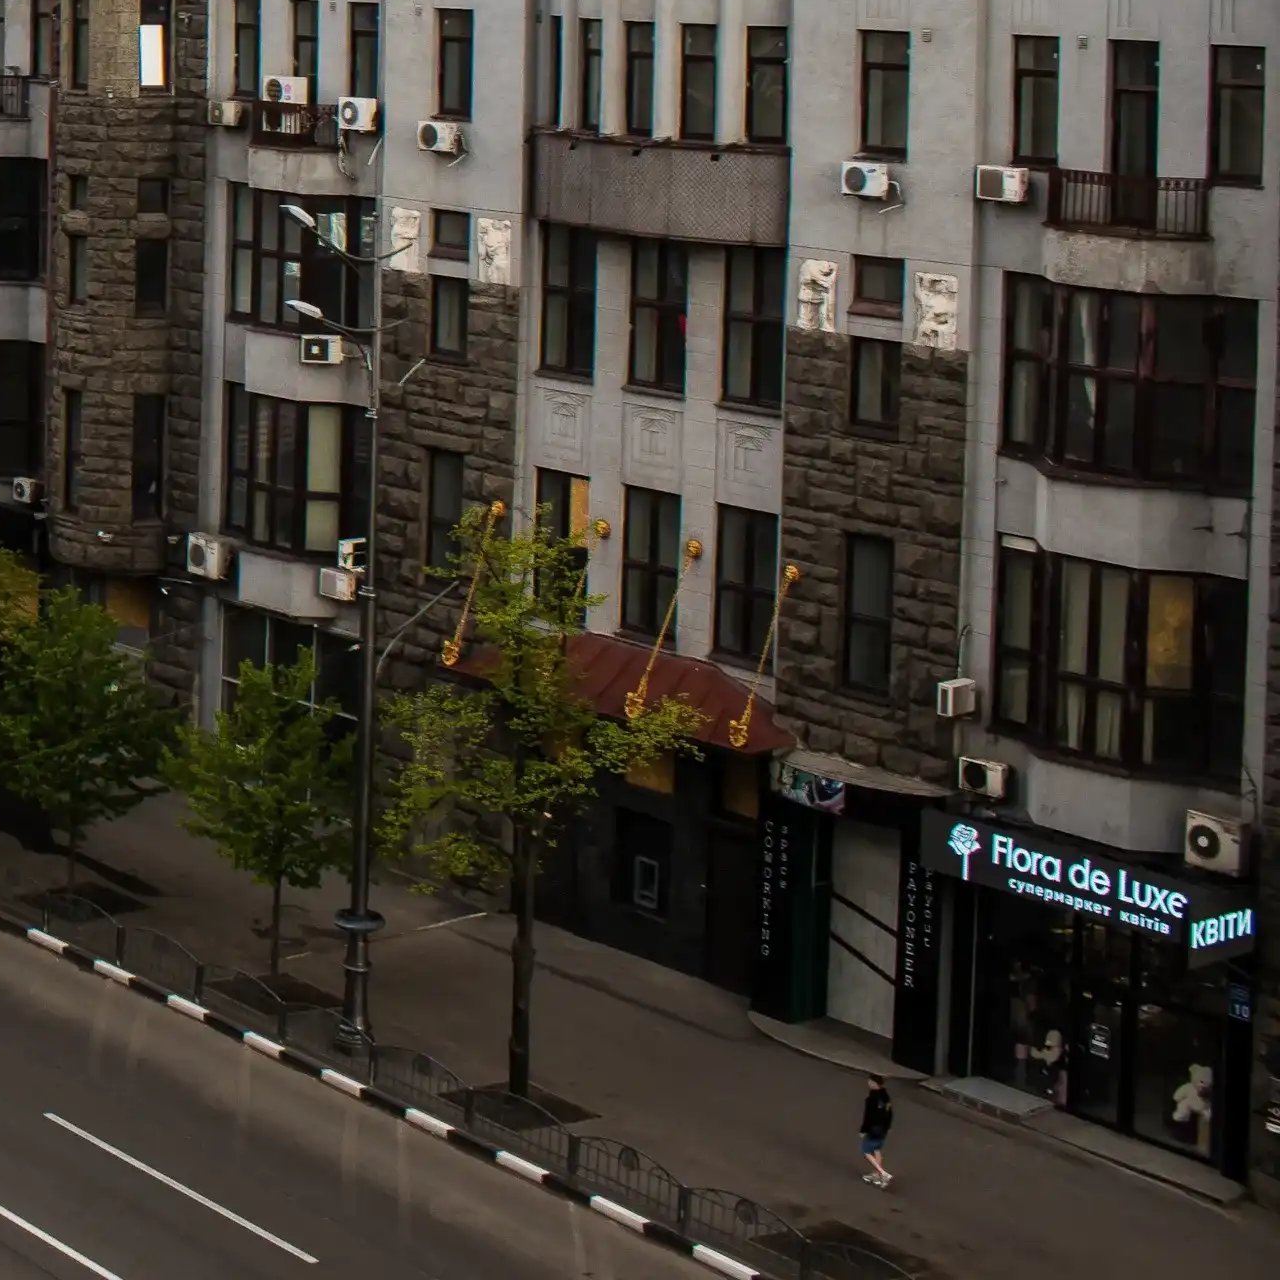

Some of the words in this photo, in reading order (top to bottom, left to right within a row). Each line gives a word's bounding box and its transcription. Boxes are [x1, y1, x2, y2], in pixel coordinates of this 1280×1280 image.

[761, 821, 774, 956] COWORKING
[992, 833, 1062, 883] Flora
[1068, 858, 1111, 896] de
[1008, 878, 1112, 916] супермаркет
[904, 862, 917, 988] PAYONEER
[1191, 908, 1253, 949] КВІТИ
[1233, 1003, 1249, 1018] 10
